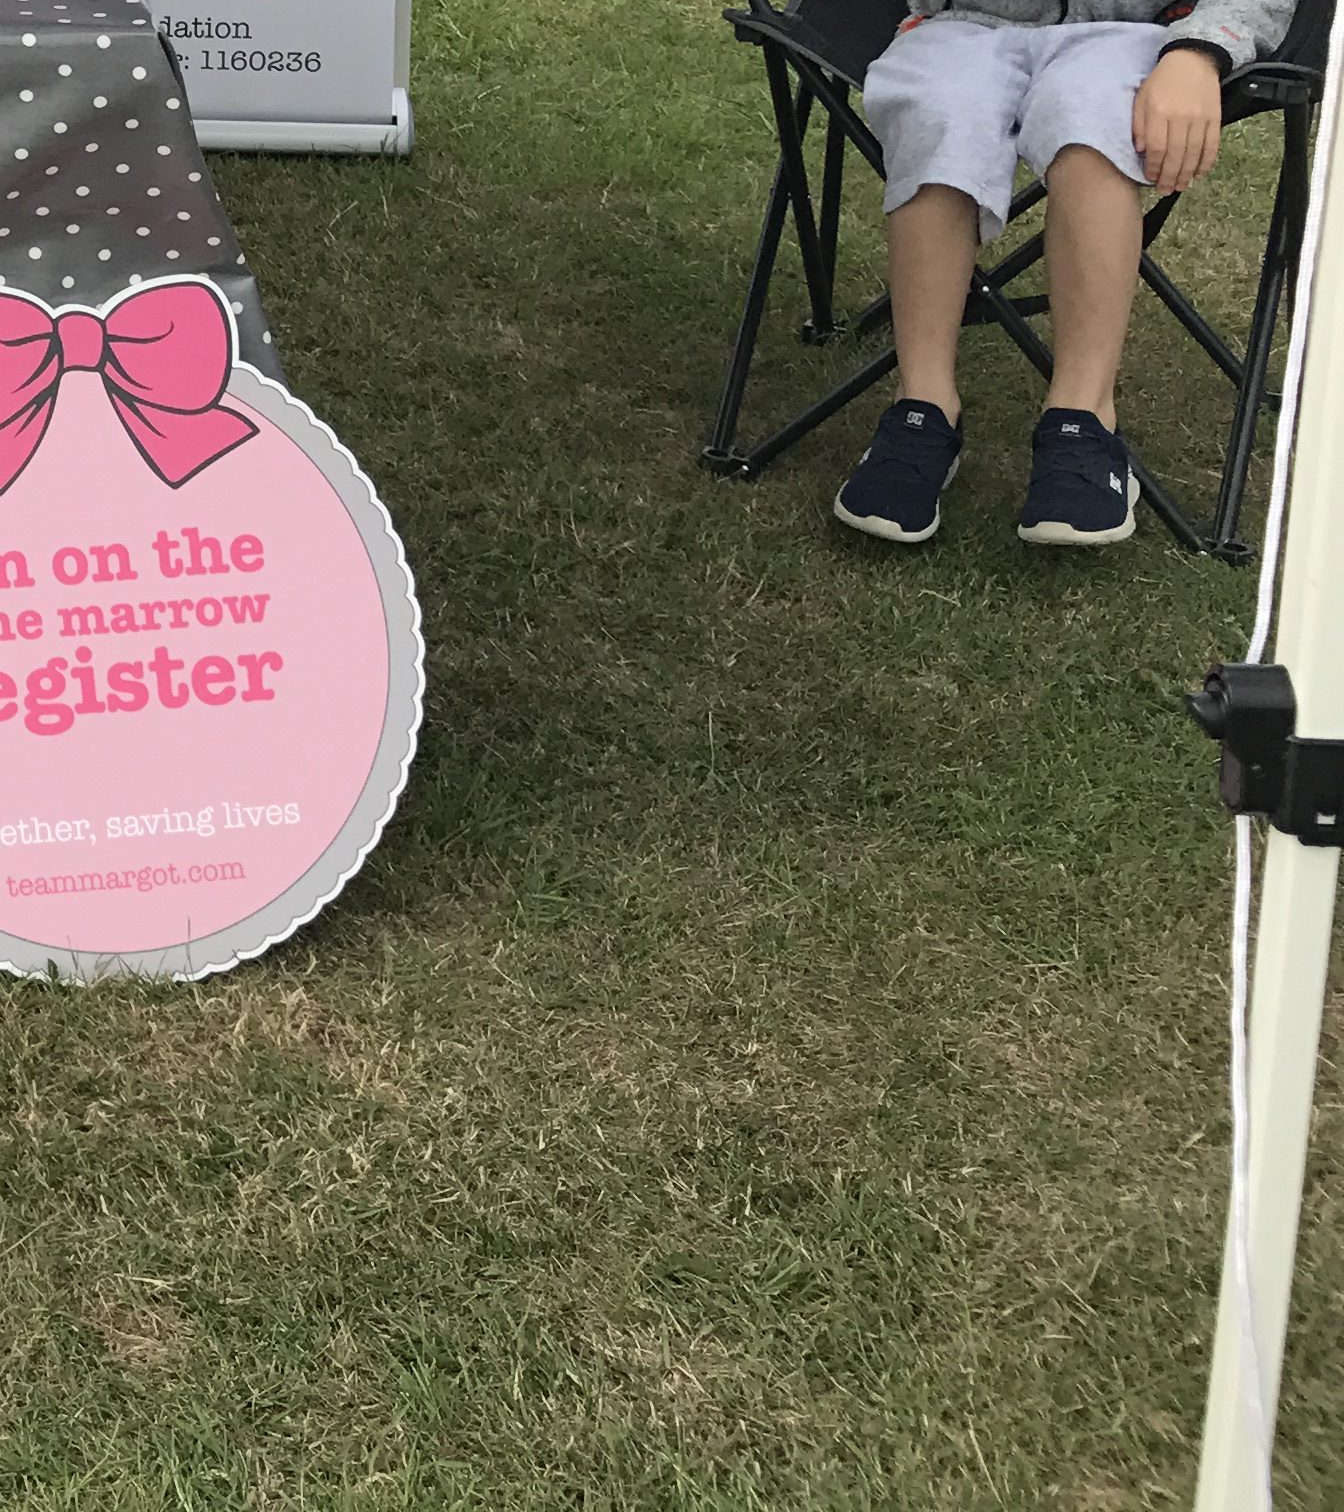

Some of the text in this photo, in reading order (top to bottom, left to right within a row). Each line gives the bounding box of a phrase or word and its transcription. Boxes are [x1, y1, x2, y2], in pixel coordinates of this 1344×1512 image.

[200, 51, 322, 73] 1160236
[52, 542, 137, 586] on
[152, 527, 265, 579] the
[58, 593, 271, 638] marrow
[5, 857, 246, 897] teammargot.com
